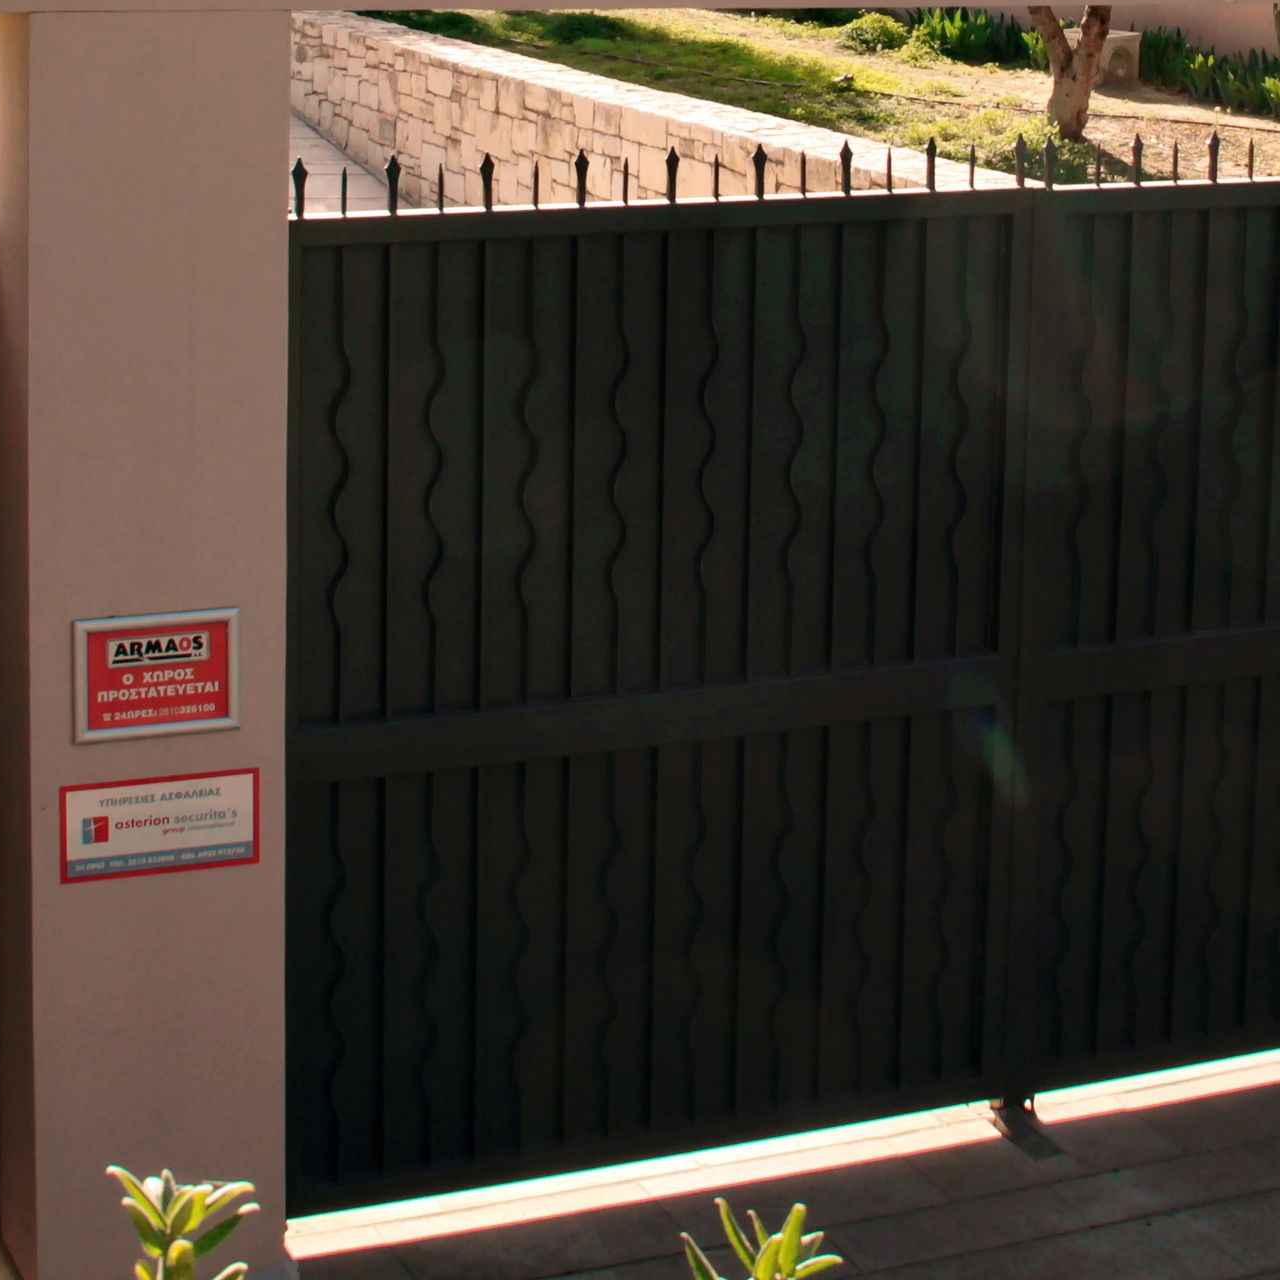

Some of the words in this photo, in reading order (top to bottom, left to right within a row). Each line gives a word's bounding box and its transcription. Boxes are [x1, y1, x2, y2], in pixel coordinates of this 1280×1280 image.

[113, 635, 204, 658] ARMAOS
[122, 673, 134, 686] Ο
[142, 668, 195, 684] ΧΩΡΟΣ
[96, 680, 220, 703] ΠΡΟΣΤΑΤΕΥΕΤΑΙ
[99, 793, 156, 808] ΥΠΗΡΕΣΙΕΣ
[160, 787, 222, 802] ΑΣΦΑΛΕΙΑΣ
[115, 815, 170, 830] asterion
